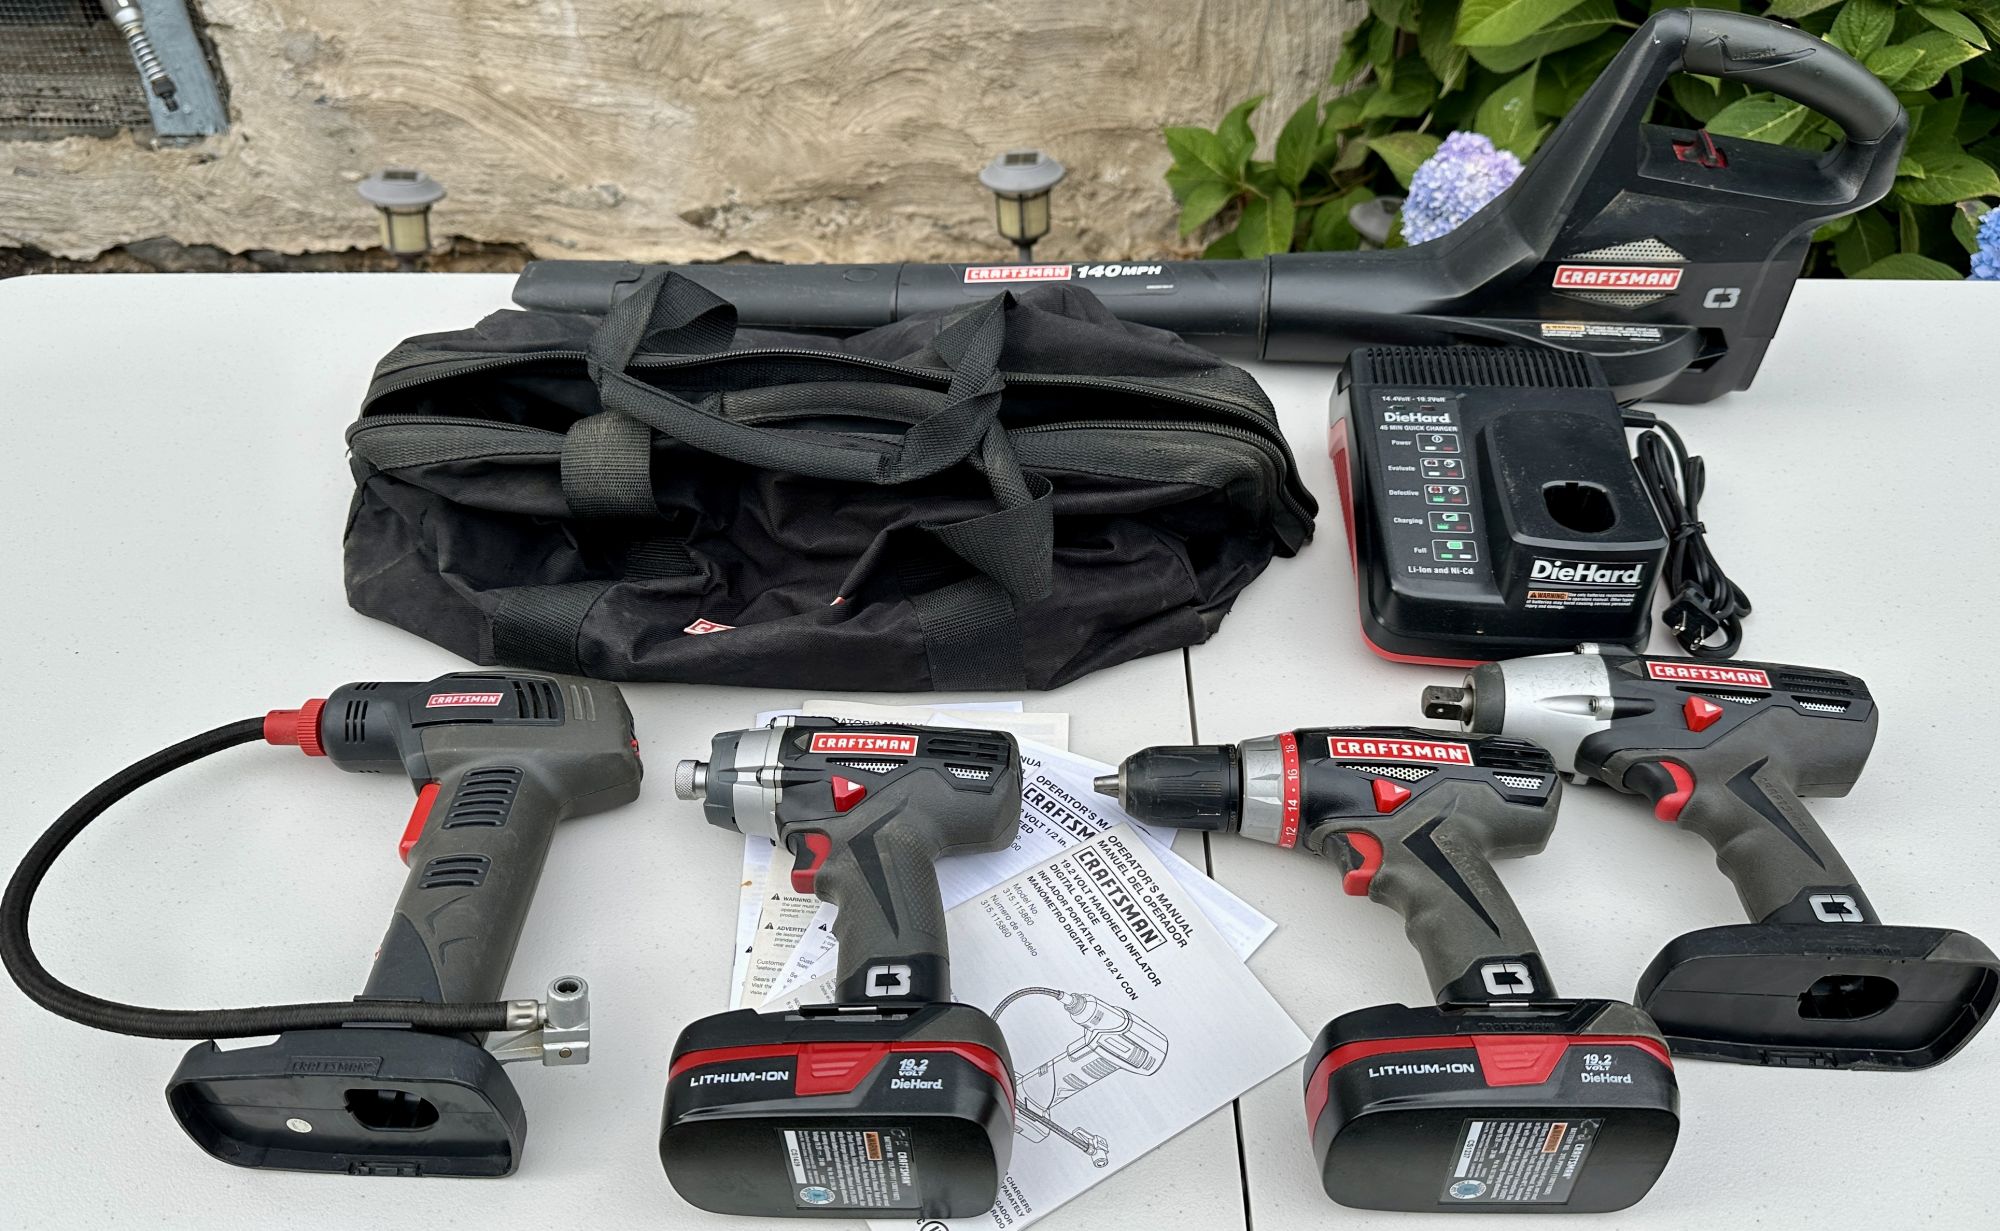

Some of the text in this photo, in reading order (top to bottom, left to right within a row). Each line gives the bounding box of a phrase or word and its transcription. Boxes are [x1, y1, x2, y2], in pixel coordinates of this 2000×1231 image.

[970, 265, 1162, 279] CRAFTSMAN 140MPH
[1560, 270, 1673, 286] CRAFTSMAN
[1702, 287, 1741, 309] C3
[1384, 412, 1451, 423] DieHard
[1393, 517, 1424, 525] Charging
[1450, 567, 1475, 575] Ni-Cd
[1530, 559, 1642, 583] DieHard
[1654, 665, 1763, 684] CRAFTSMAN
[431, 695, 497, 705] CRAFTSMAN
[817, 736, 911, 751] CRAFTSMAN
[1336, 741, 1463, 762] CRAFTSMAN
[1287, 769, 1298, 781] 16
[1036, 775, 1098, 821] OPERATOR'S
[1287, 799, 1298, 812] 14
[1024, 812, 1046, 829] VOLT
[1045, 828, 1059, 840] 1/2
[1286, 826, 1297, 836] 12
[1012, 882, 1029, 905] Model
[1049, 863, 1101, 926] DIGITAL GAUGE
[1078, 850, 1159, 944] CRAFTSMAN
[1097, 840, 1188, 948] MANUEL DEL OPERADOR
[1107, 835, 1194, 938] OPERATOR'S MANUAL
[1027, 875, 1089, 956] MANÓMETRO DIGITAL
[1808, 894, 1864, 923] C3
[1037, 870, 1139, 1001] INFLADOR PORTÁTIL DE 19,2 V CON
[1060, 859, 1162, 987] 19.2 VOLT HANDHELD INFLATOR
[1009, 921, 1018, 931] de
[1017, 930, 1038, 957] modelo
[865, 964, 912, 997] C3
[1480, 963, 1535, 996] C3
[690, 1058, 929, 1087] LITHIUM-ION 19.2
[1369, 1054, 1613, 1078] LITHIUM-ION 19.2
[1580, 1072, 1634, 1085] DieHard
[890, 1077, 944, 1090] DieHard
[897, 1151, 911, 1186] CRAFTSMAN
[1563, 1143, 1584, 1177] CRAFTSMAN
[1001, 1181, 1025, 1217] PARATELY
[1006, 1176, 1032, 1214] CHARGERS
[995, 1199, 1014, 1225] GADOR
